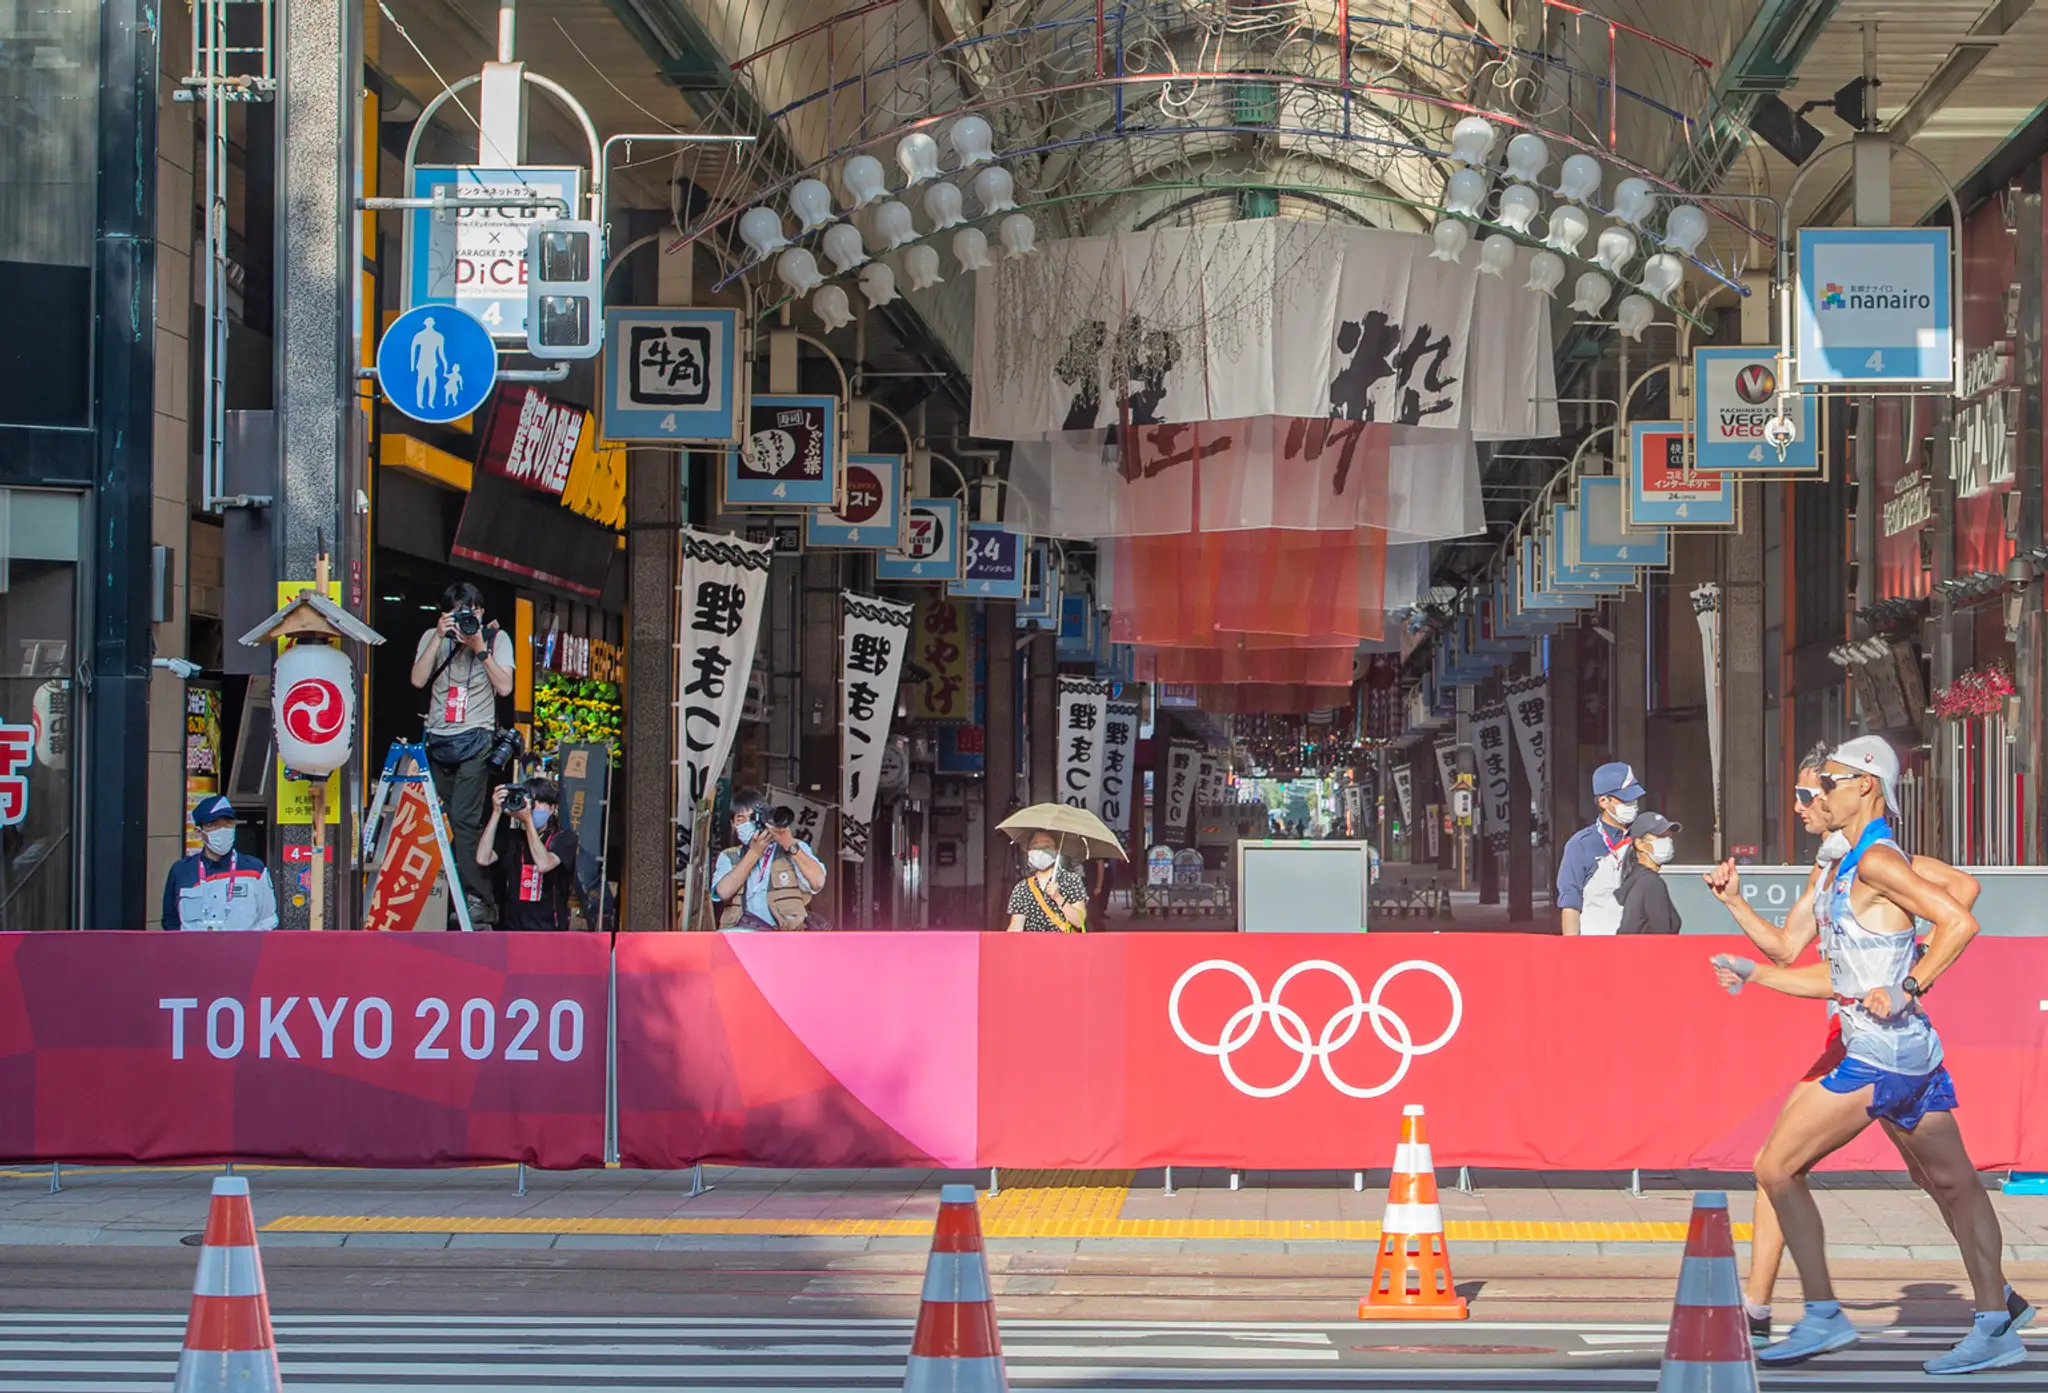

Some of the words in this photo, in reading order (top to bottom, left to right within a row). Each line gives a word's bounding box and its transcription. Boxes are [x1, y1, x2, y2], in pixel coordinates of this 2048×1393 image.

[1850, 288, 1931, 309] nanairo
[481, 301, 503, 325] 4
[640, 341, 702, 387] 牛角
[1865, 350, 1885, 372] 4
[660, 413, 677, 433] 4
[1748, 444, 1764, 462] 4
[772, 483, 786, 498] 4
[1676, 503, 1689, 518] 4
[847, 528, 860, 543] 4
[1616, 547, 1629, 560] 4
[912, 562, 923, 575] 4
[979, 581, 991, 593] 4
[158, 997, 393, 1061] TOKYO
[414, 997, 586, 1062] 2020
